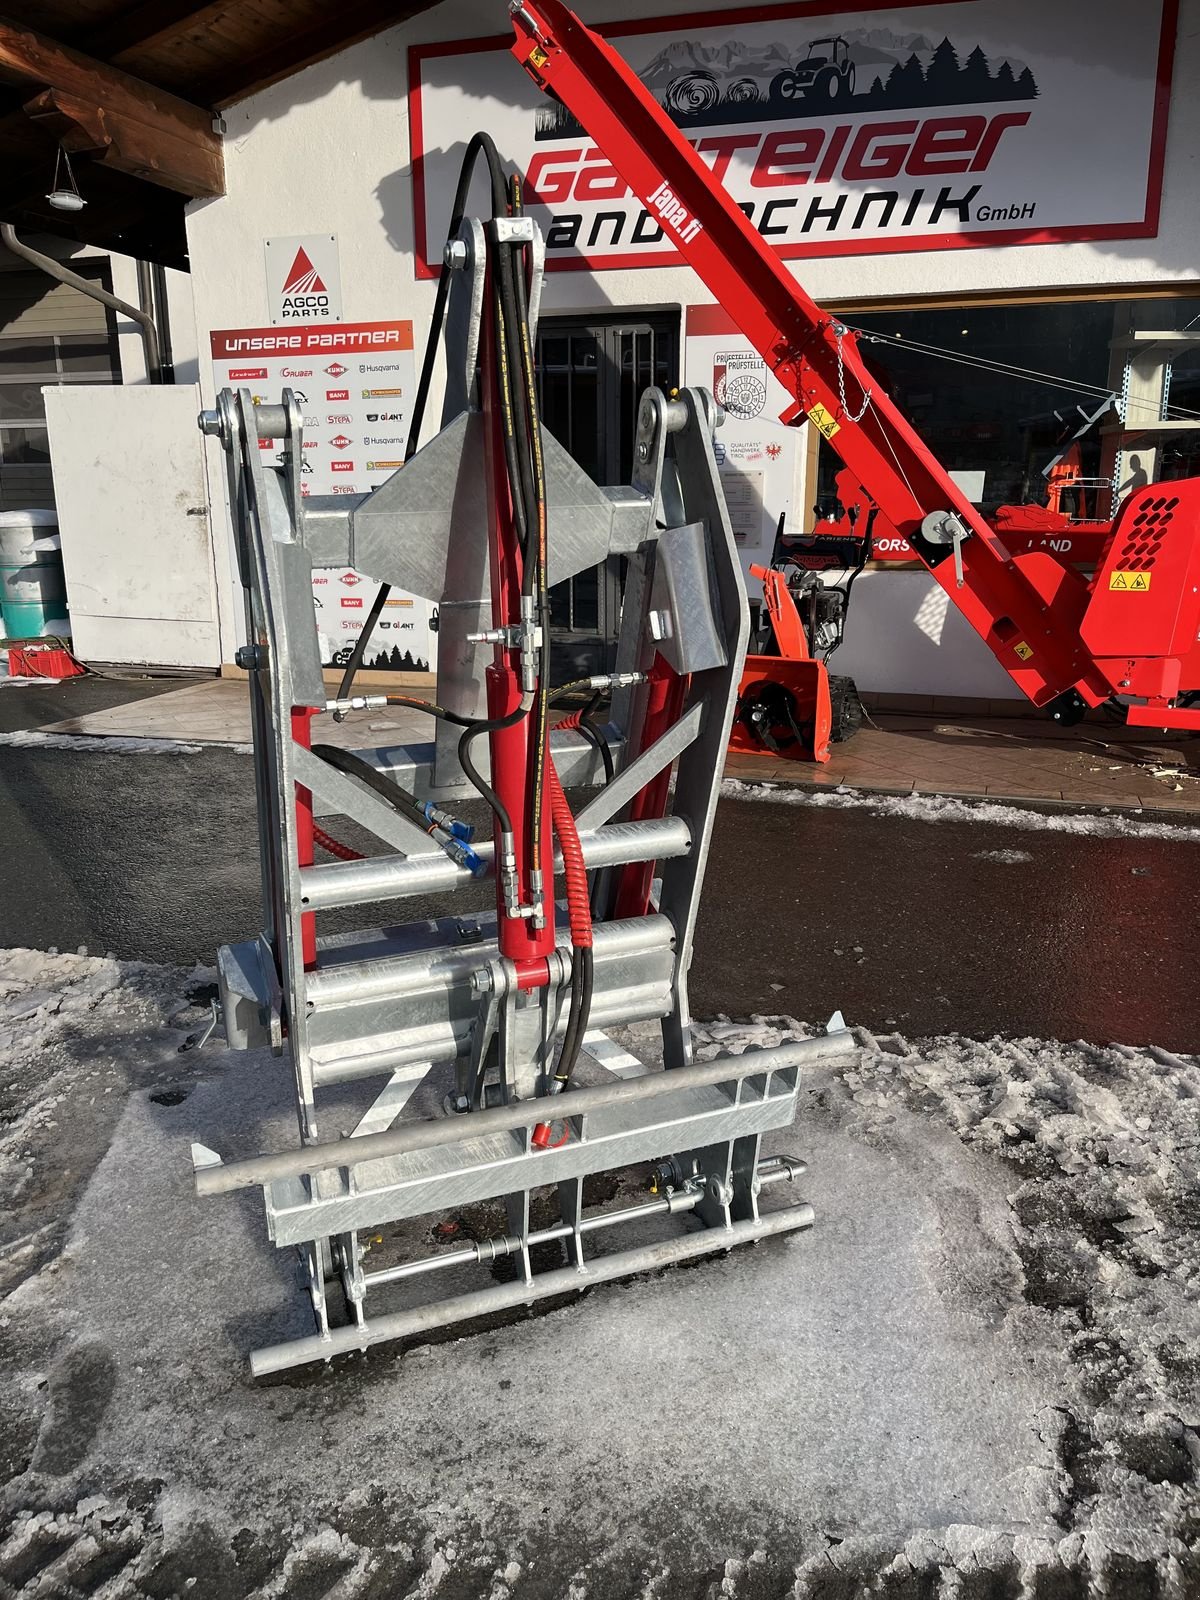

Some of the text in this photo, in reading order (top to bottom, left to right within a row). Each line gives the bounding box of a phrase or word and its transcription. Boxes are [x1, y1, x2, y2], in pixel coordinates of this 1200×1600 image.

[524, 112, 1032, 205] GaTeIGer
[646, 180, 703, 245] japa.fi
[976, 203, 1036, 222] GmbH
[282, 296, 329, 309] AGCO
[282, 308, 329, 318] PARTS
[366, 364, 400, 373] Husqvarna
[728, 360, 765, 370] PRÜFSTELLE
[282, 367, 313, 377] GRUBER
[327, 415, 351, 424] STEPA
[370, 437, 404, 445] Husqvarna
[332, 486, 356, 494] STEPA
